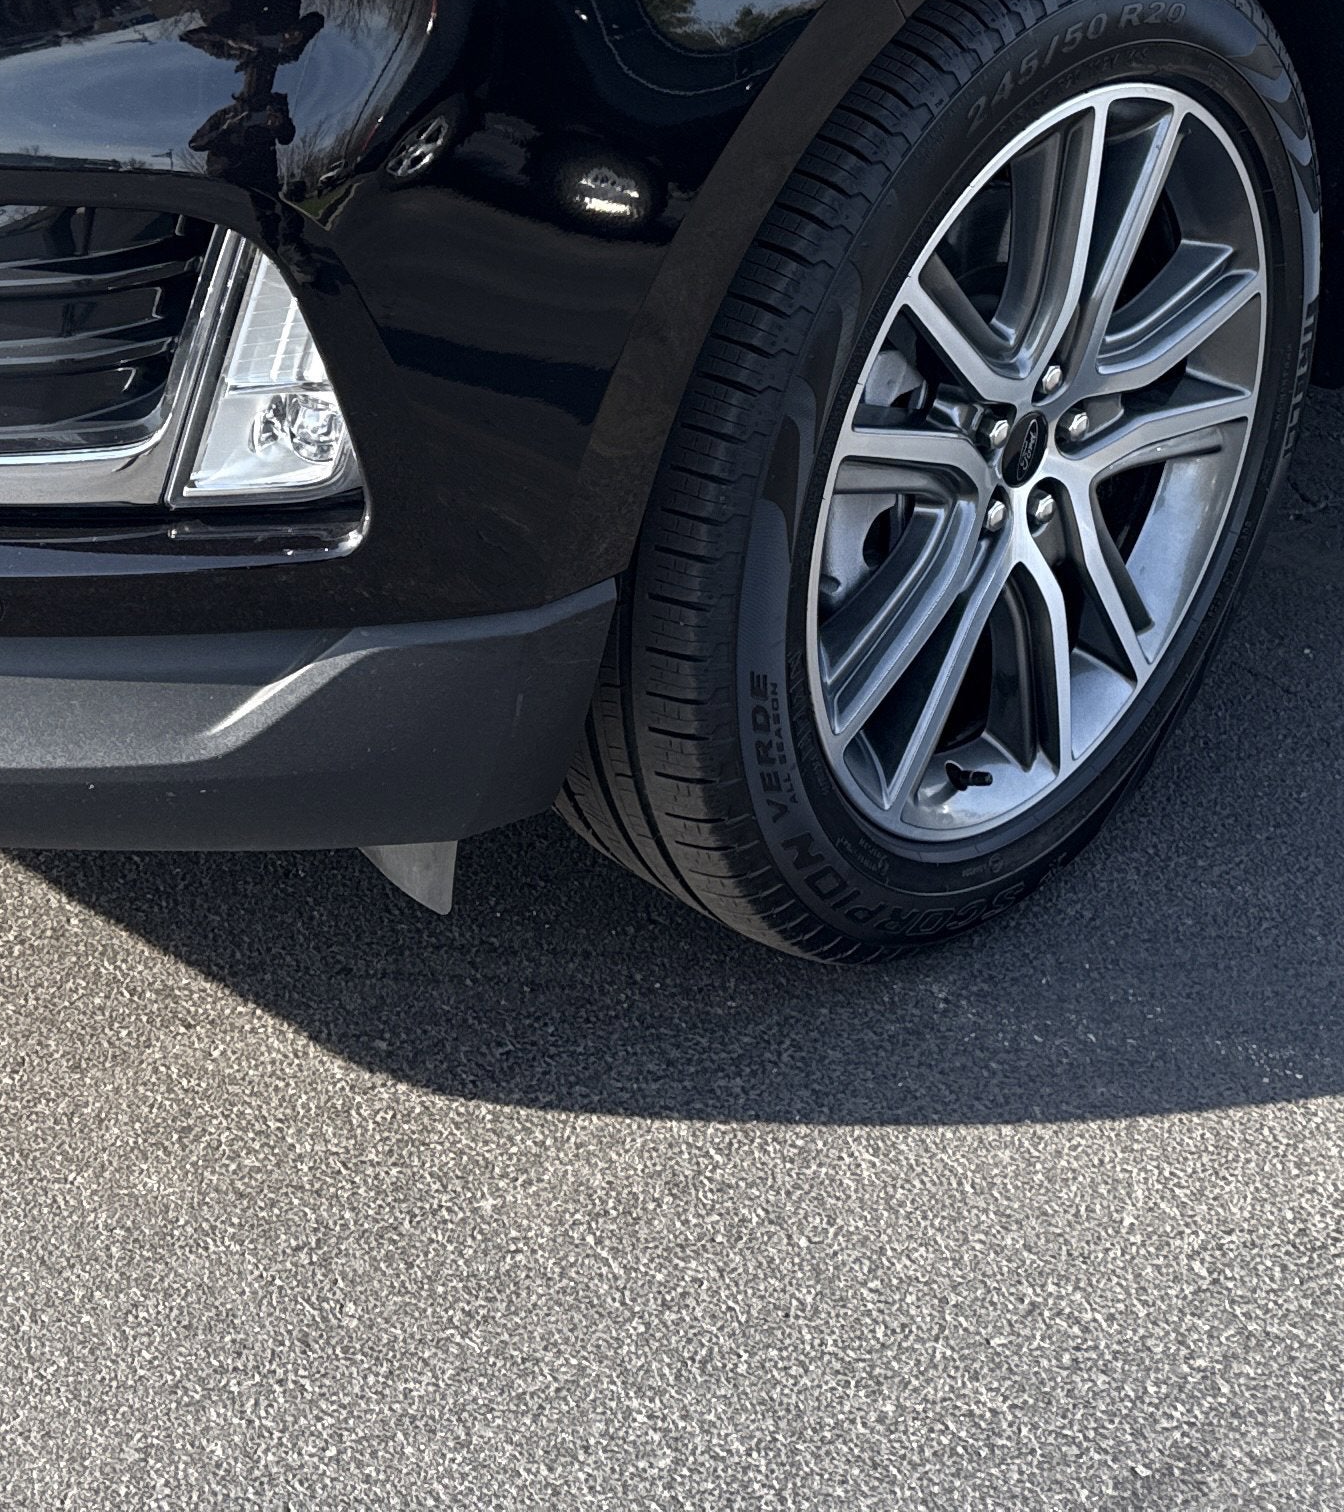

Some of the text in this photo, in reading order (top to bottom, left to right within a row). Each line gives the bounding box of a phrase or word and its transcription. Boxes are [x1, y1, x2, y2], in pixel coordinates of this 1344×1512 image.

[967, 1, 1187, 134] 245/50 R20
[750, 670, 1025, 936] SCORPION VERDE
